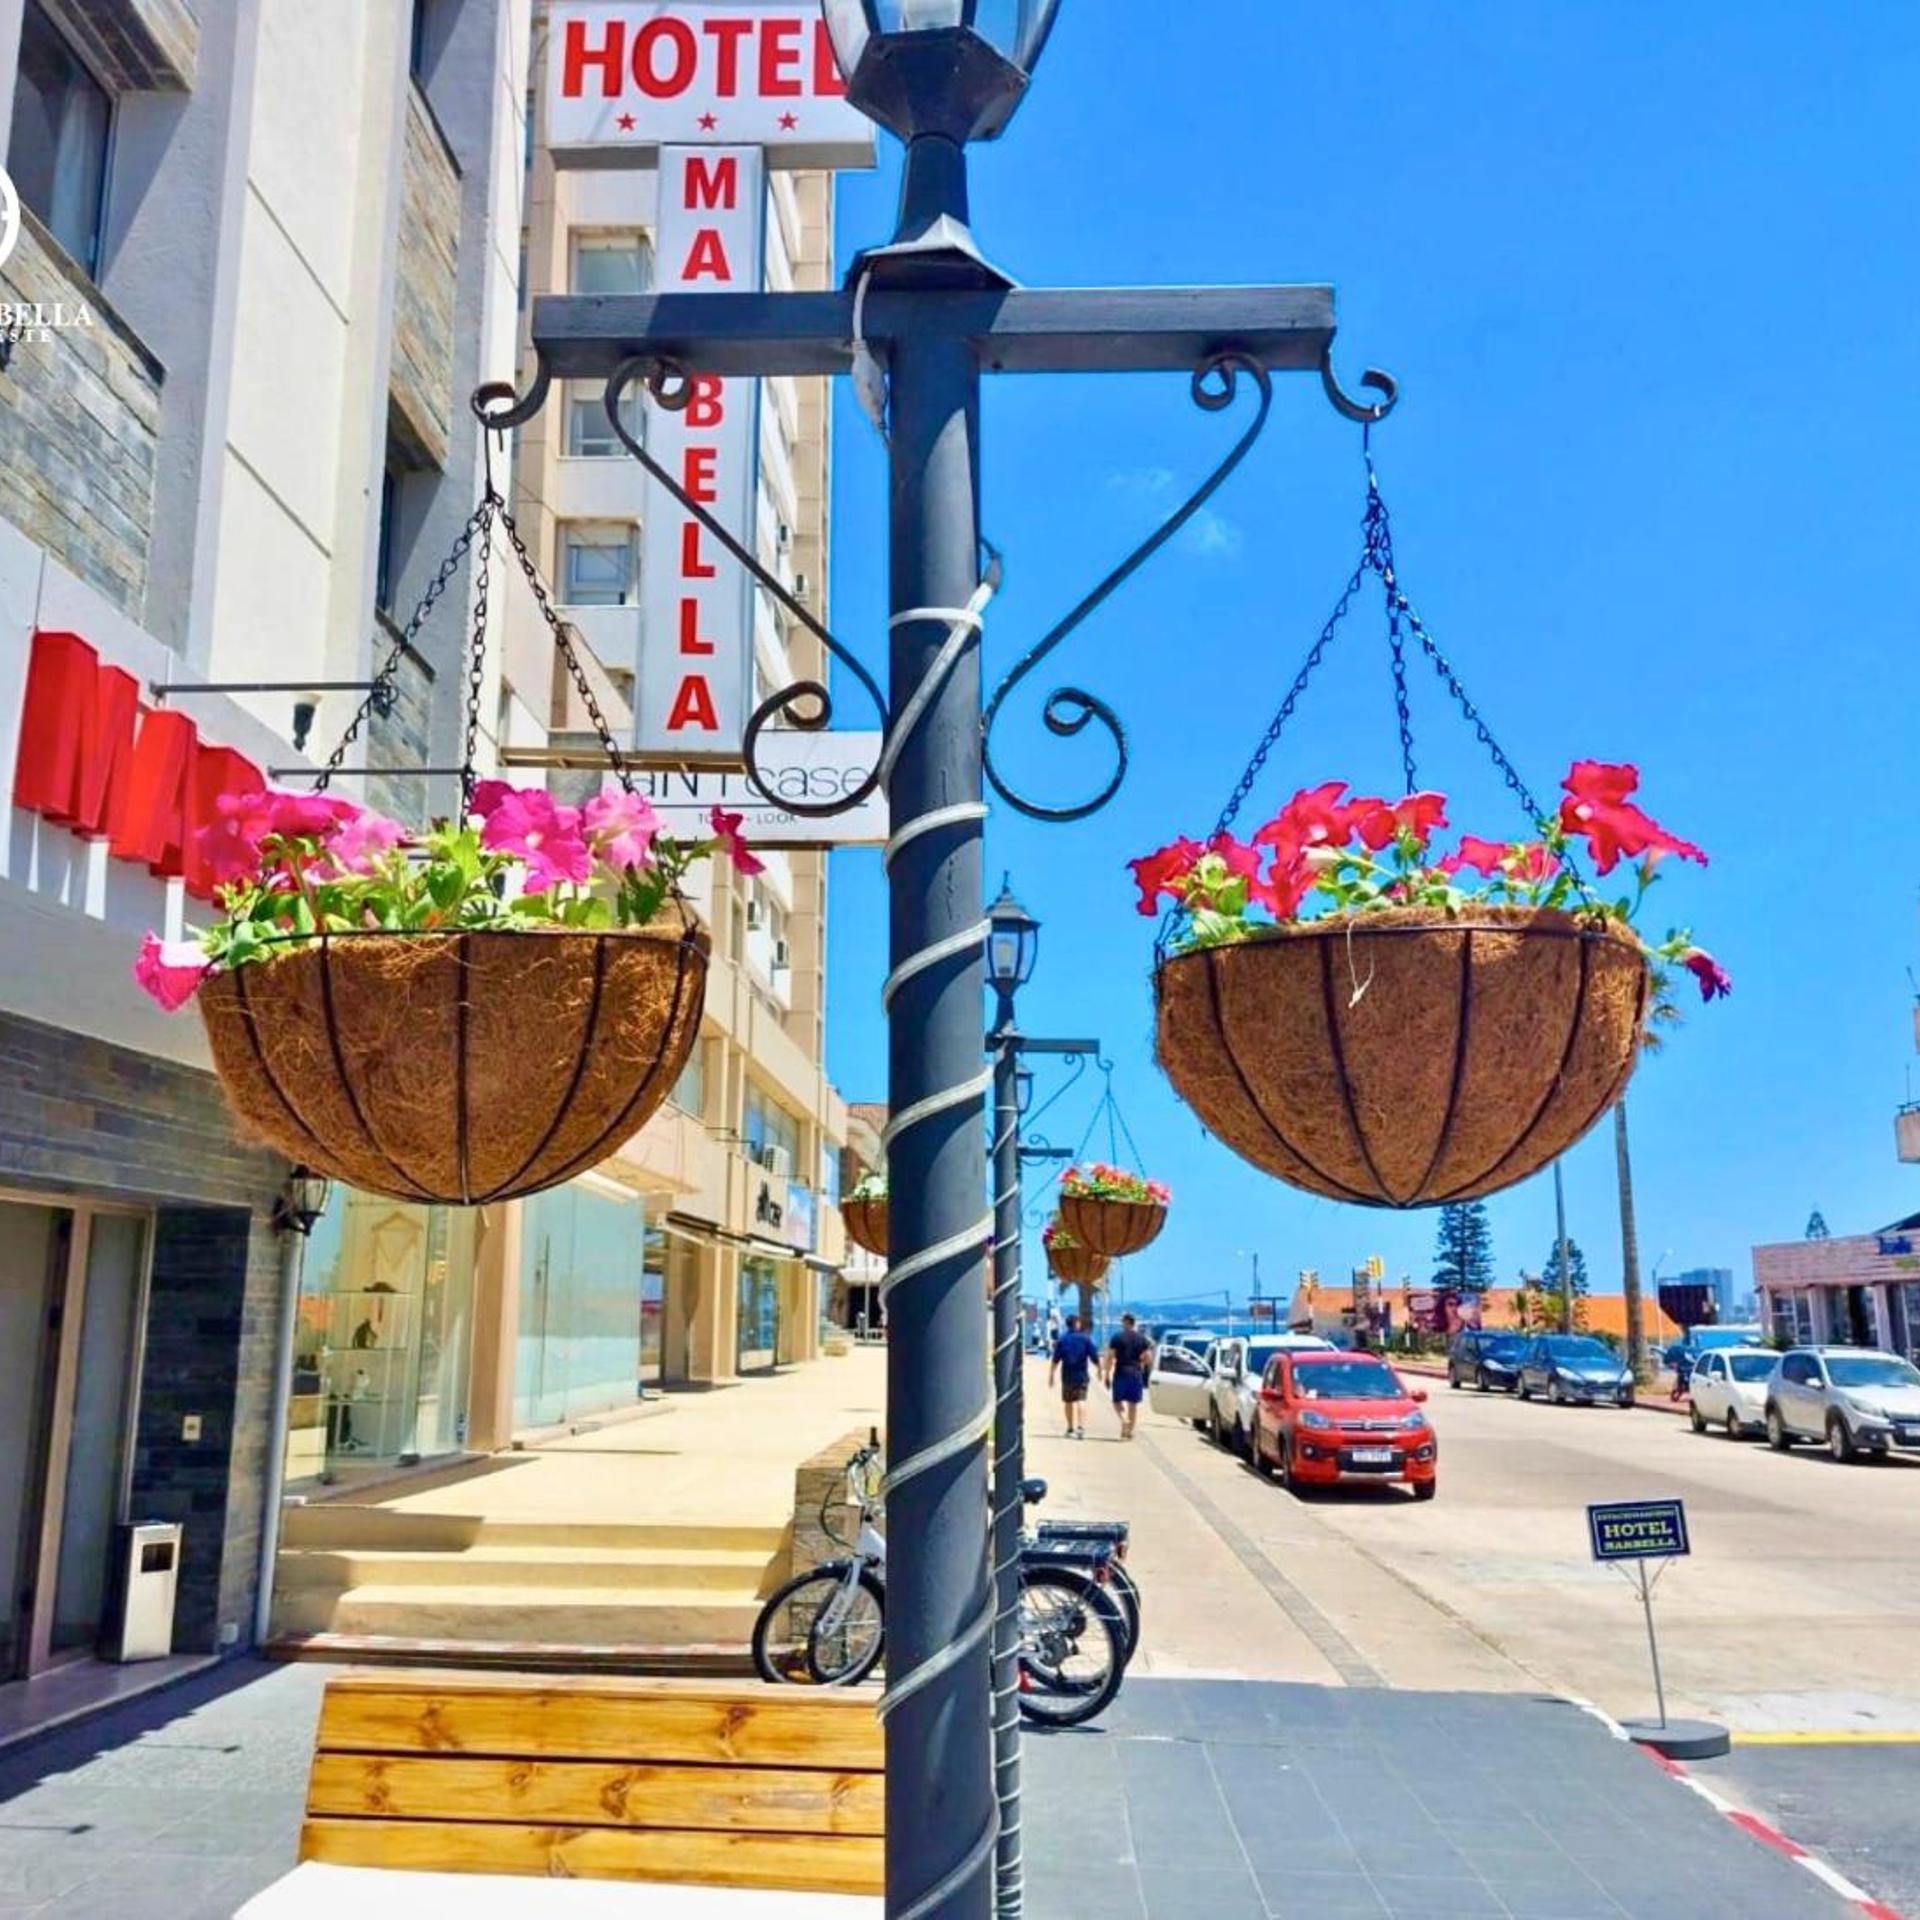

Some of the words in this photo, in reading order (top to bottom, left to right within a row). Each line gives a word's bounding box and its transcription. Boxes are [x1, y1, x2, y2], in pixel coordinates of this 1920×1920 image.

[562, 17, 848, 99] HOTEL
[666, 157, 737, 731] MABELLA
[1604, 1521, 1673, 1538] HOTEL
